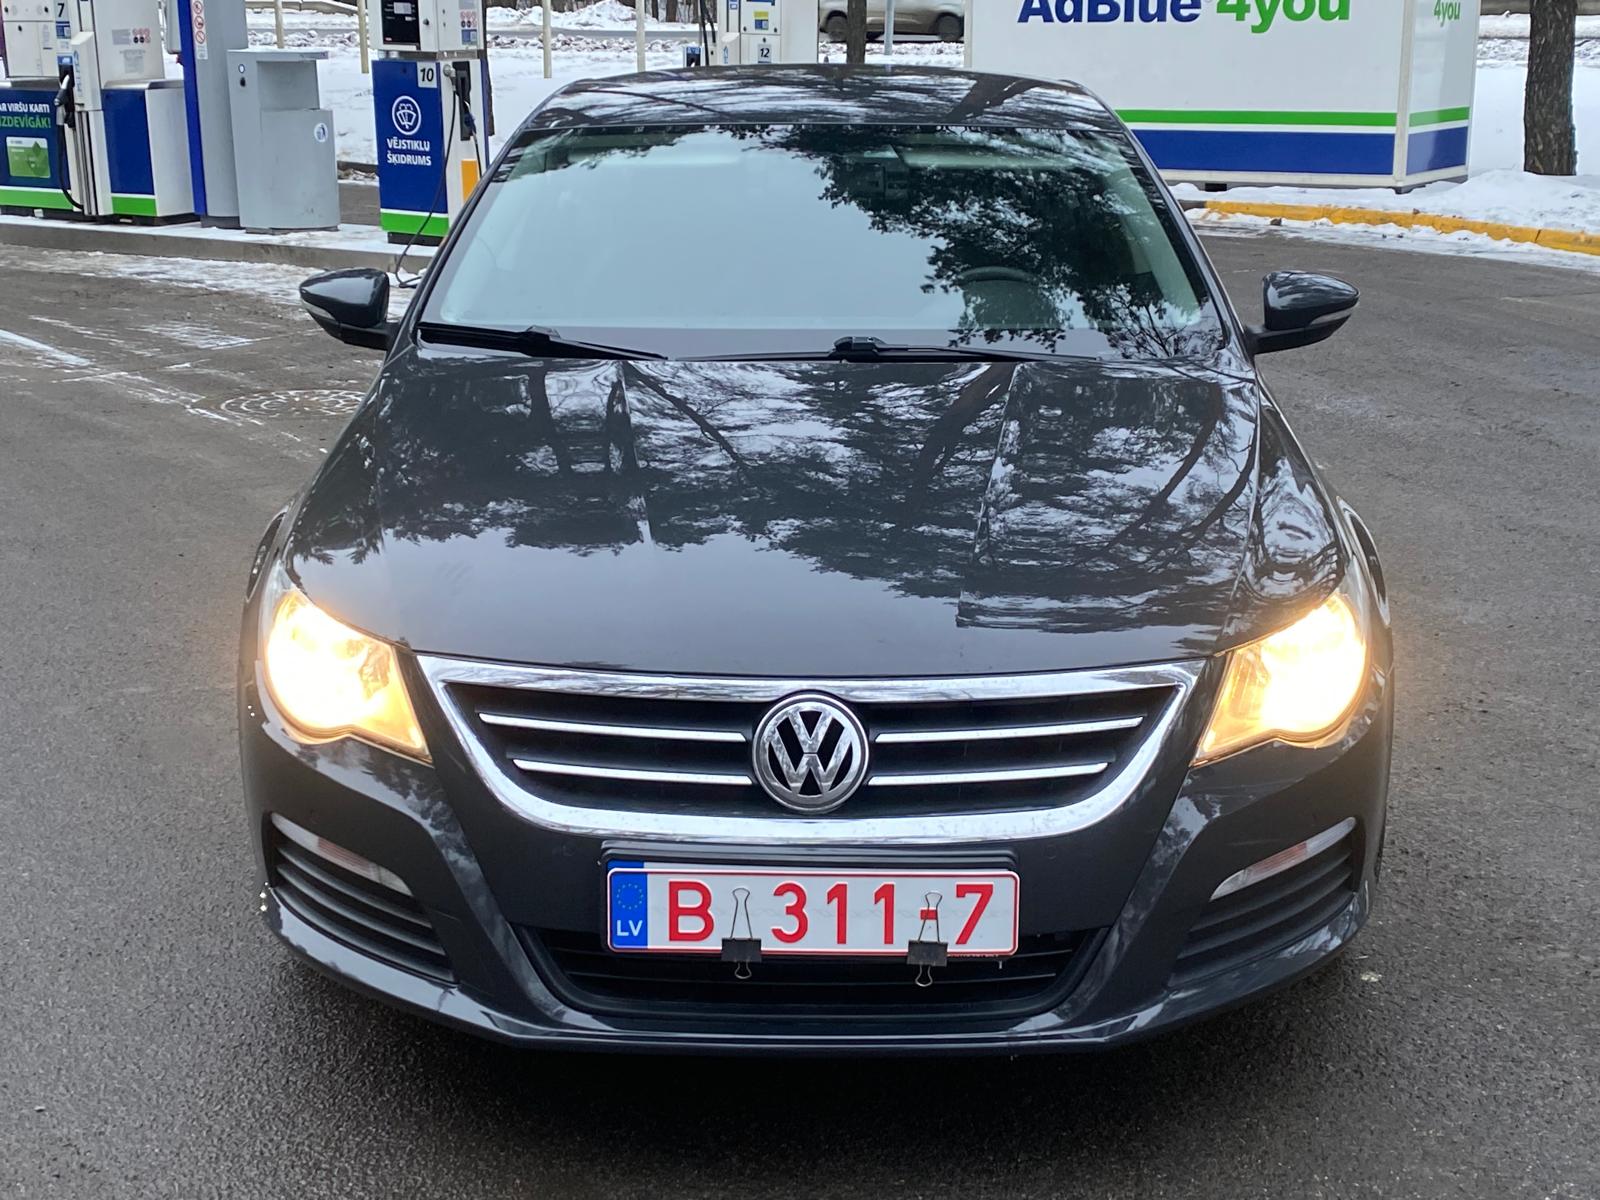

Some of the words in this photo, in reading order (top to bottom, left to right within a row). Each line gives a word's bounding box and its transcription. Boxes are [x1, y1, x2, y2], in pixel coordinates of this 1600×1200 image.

[57, 3, 65, 17] 7
[1216, 0, 1349, 33] 4you
[1433, 0, 1461, 27] 4you
[759, 47, 770, 58] 12
[420, 67, 435, 82] 10
[386, 136, 431, 152] VĒJSTIKLU
[668, 881, 715, 942] B
[771, 882, 994, 944] 311-7
[616, 920, 643, 938] LV
